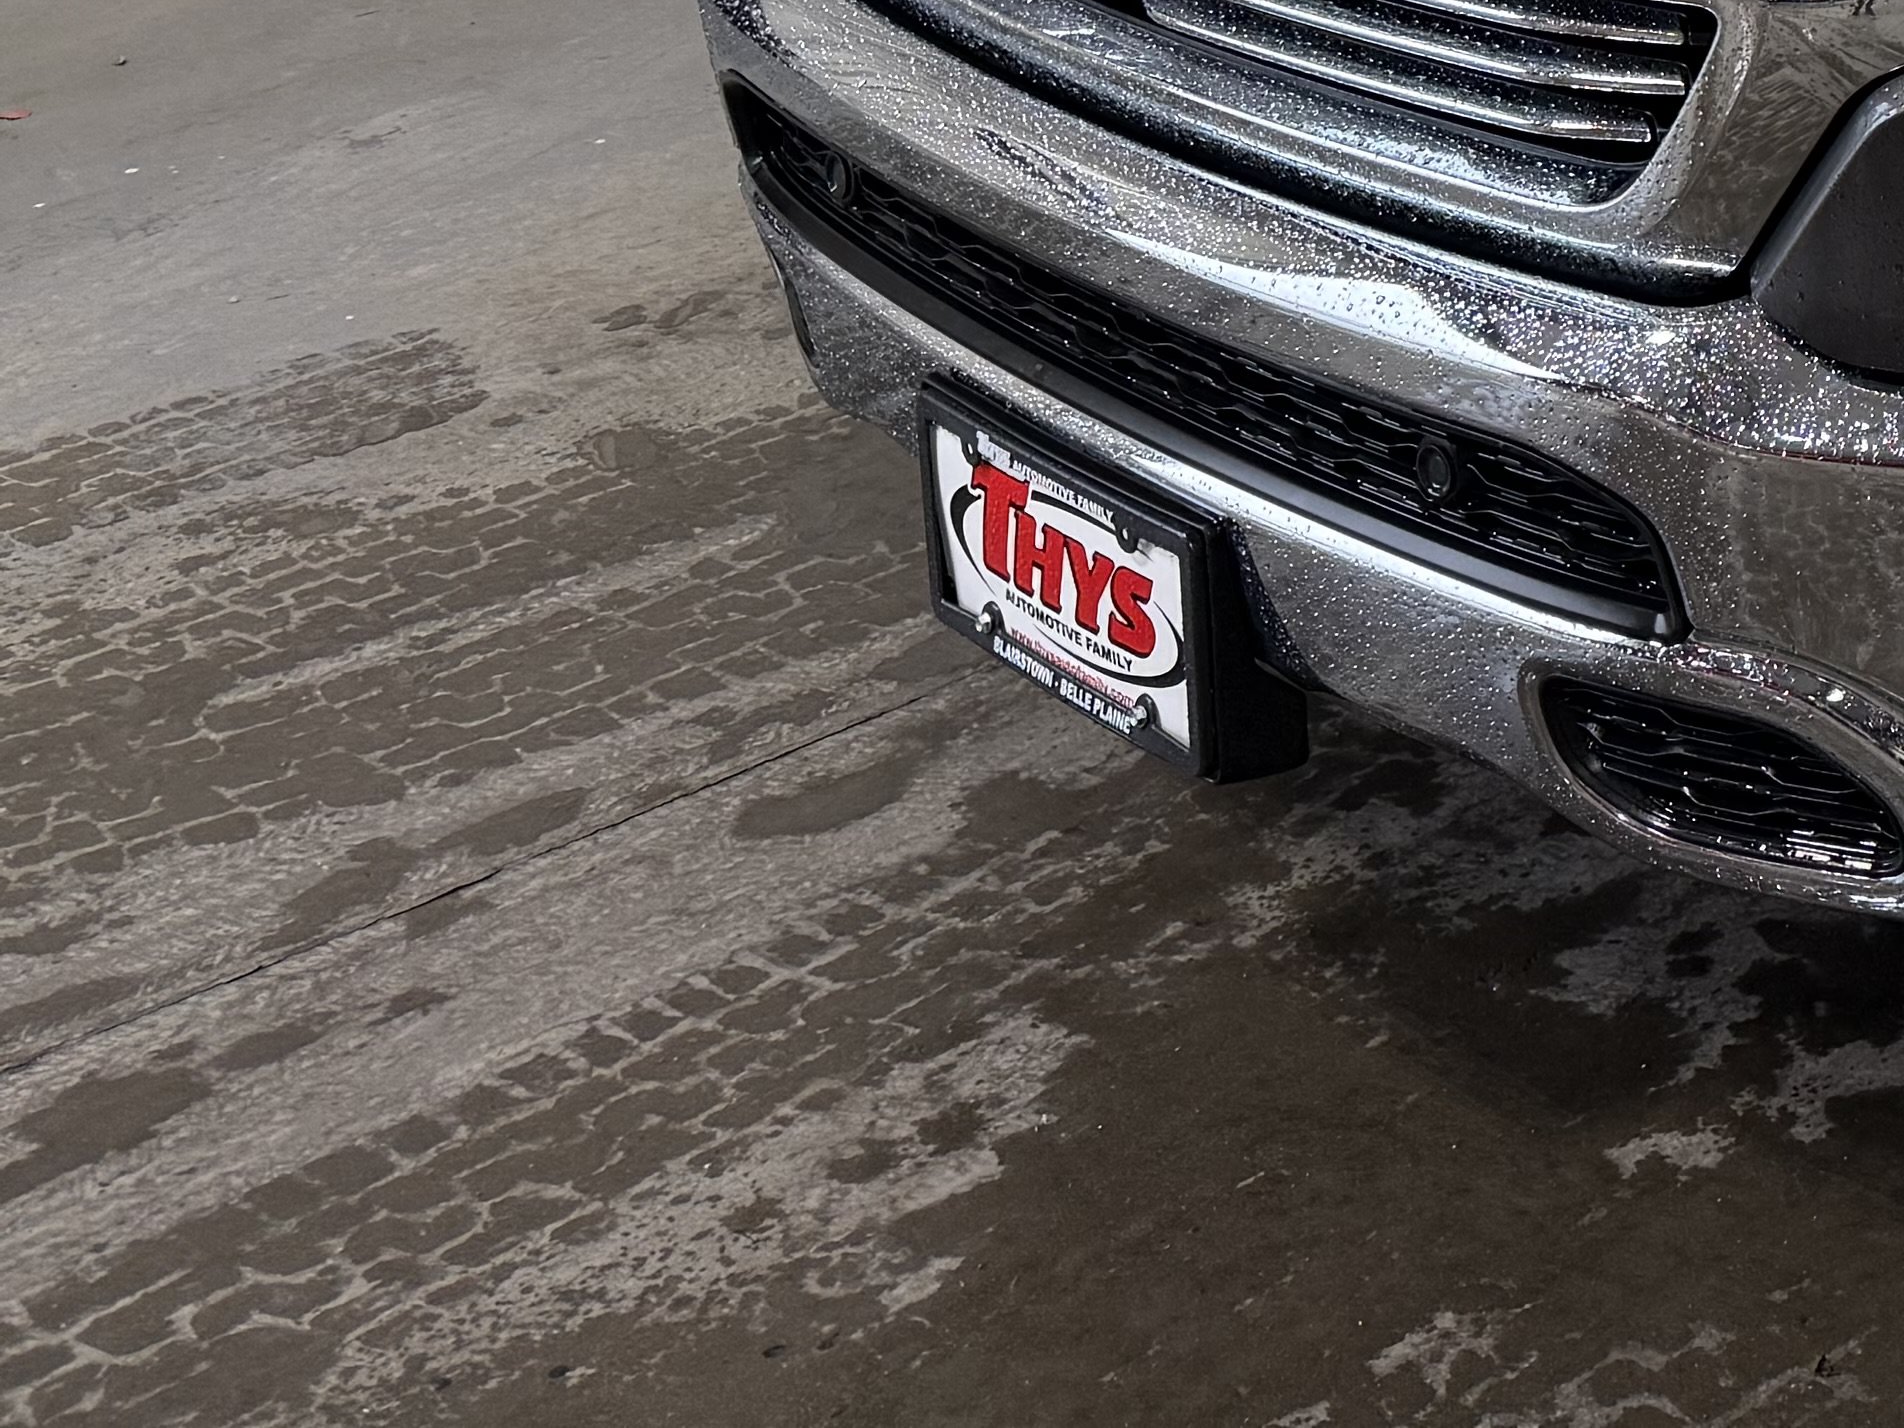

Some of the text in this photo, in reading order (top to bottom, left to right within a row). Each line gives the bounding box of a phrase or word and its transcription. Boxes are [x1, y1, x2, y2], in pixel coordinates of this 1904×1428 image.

[1077, 494, 1115, 527] FAMILY
[972, 461, 1156, 659] THYS
[1006, 588, 1133, 672] AUTOMOTIVE FAMILY
[993, 635, 1133, 735] BLAIRSTOWN BELLE PLAINE
